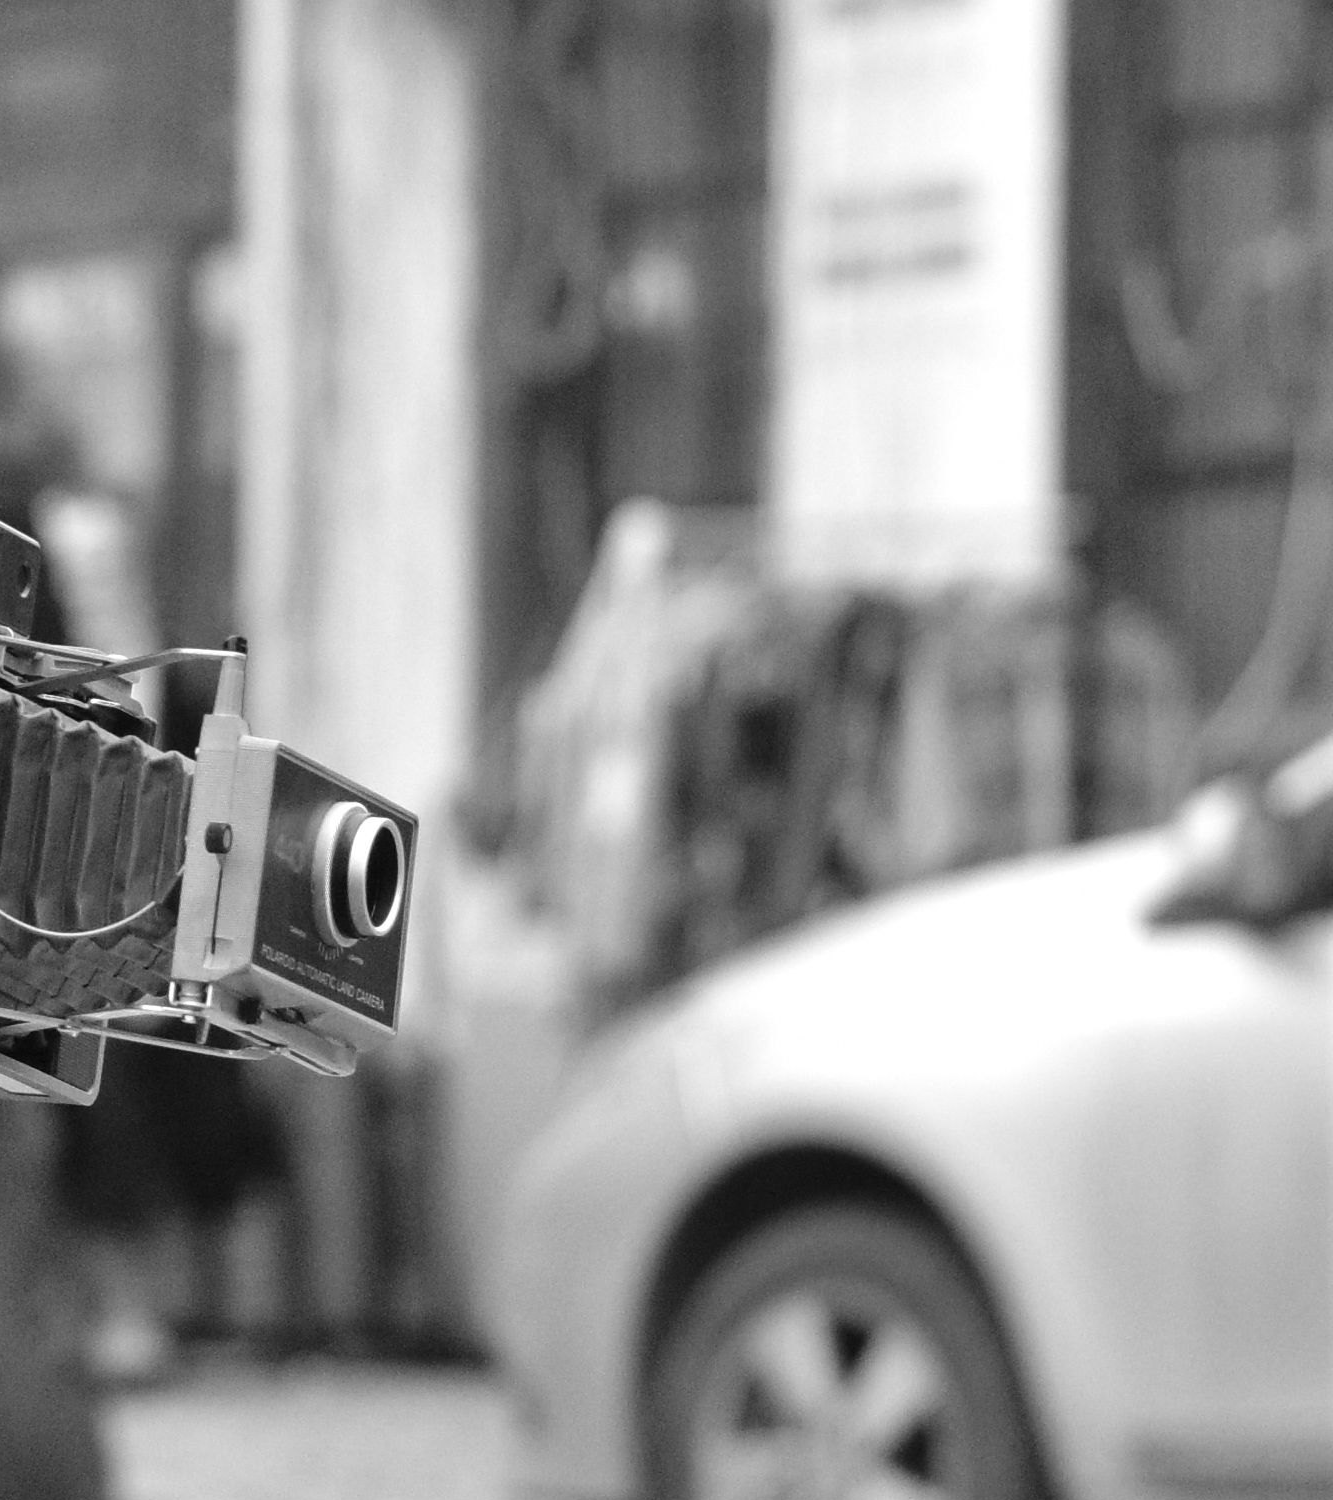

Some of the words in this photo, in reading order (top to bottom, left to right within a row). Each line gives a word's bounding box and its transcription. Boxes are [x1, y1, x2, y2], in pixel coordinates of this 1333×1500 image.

[261, 943, 295, 970] POLAROID
[296, 961, 336, 990] AUTOMATIC
[336, 980, 355, 998] LAND
[356, 987, 385, 1011] CAMERA
